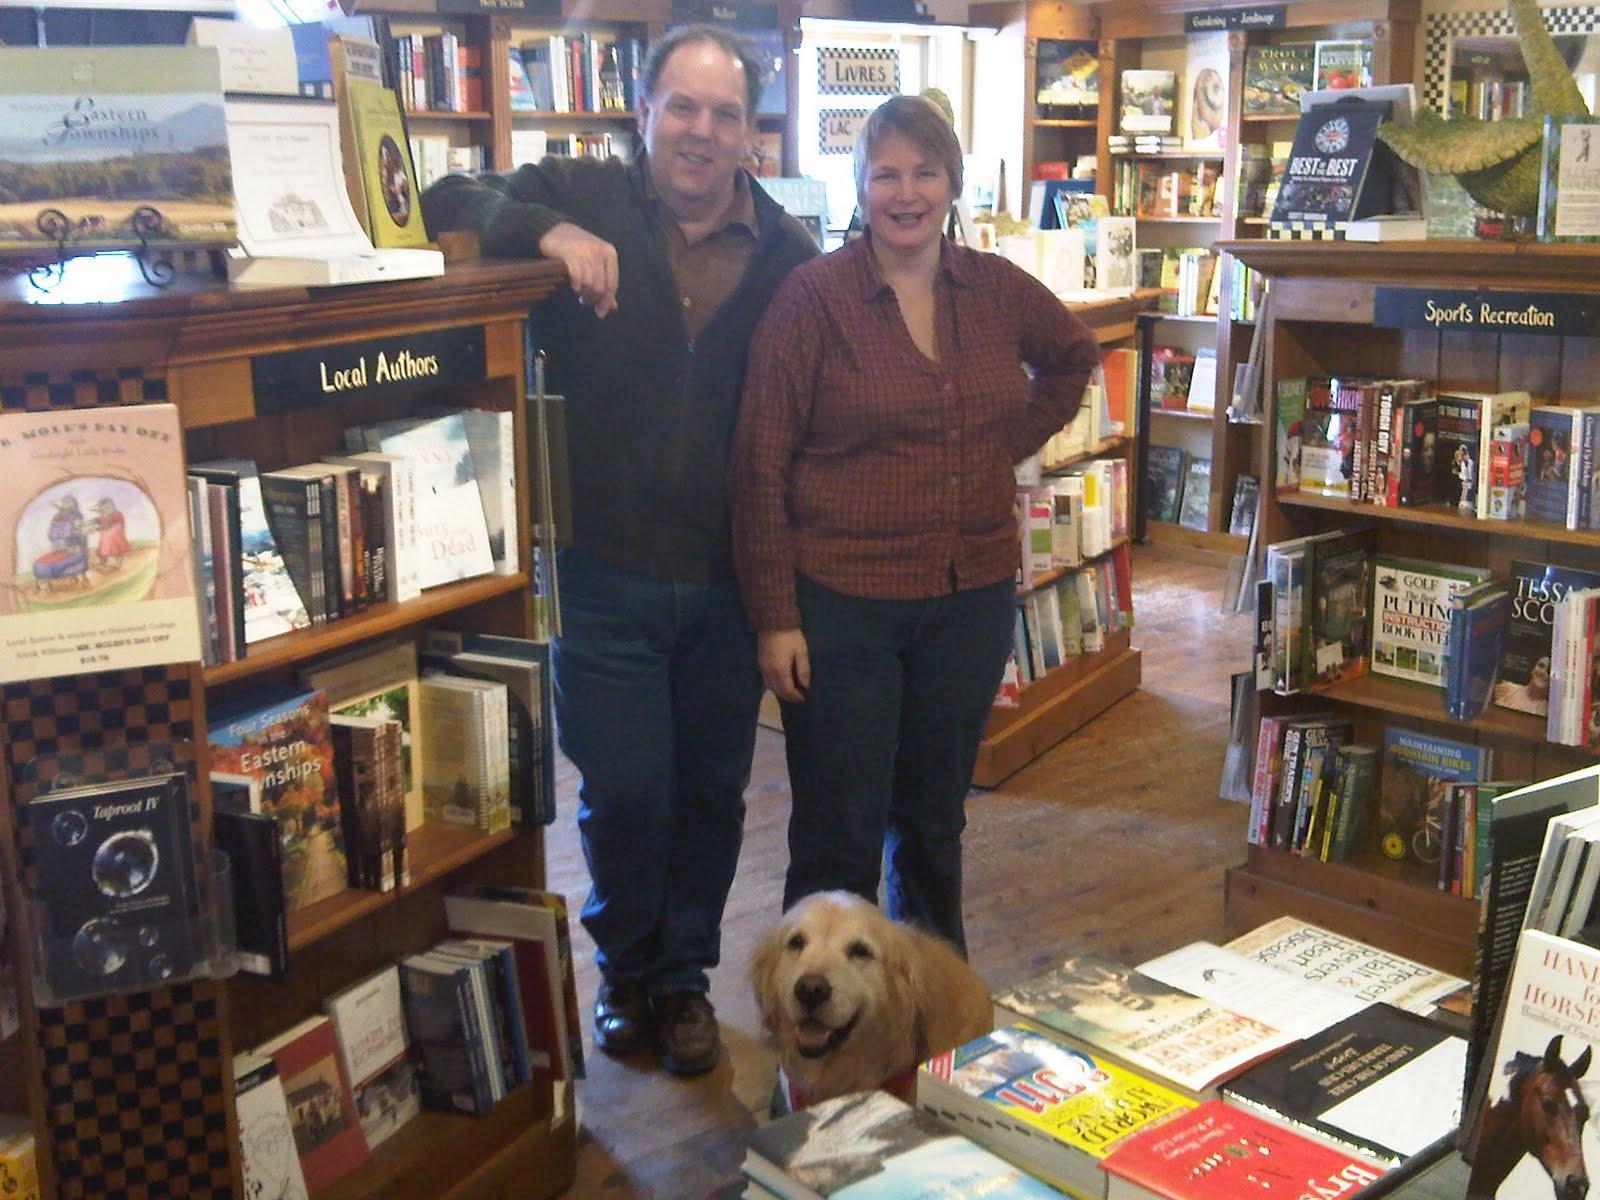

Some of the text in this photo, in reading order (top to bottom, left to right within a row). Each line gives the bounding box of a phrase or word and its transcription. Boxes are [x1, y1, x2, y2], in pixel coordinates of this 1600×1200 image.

[835, 61, 887, 83] LIVRES
[64, 96, 147, 129] Eastern
[42, 124, 159, 146] Townships
[1289, 157, 1320, 175] BEST
[1326, 158, 1358, 177] BEST
[1424, 299, 1554, 327] Sports Recreation
[319, 349, 439, 393] Local Authors
[1377, 394, 1393, 455] TOUGH GUY
[431, 533, 477, 560] Dead
[1403, 575, 1438, 590] GOLF
[1516, 576, 1574, 604] TESSA
[1382, 622, 1415, 639] BOOK
[228, 703, 310, 737] Four Seasons
[240, 740, 306, 773] Eastern
[1399, 736, 1462, 759] MAINTAINING
[93, 796, 160, 821] Taproot IV
[1248, 927, 1329, 966] Disease
[1287, 935, 1355, 968] Heart
[1303, 943, 1381, 983] Revers
[1357, 955, 1406, 979] Halt
